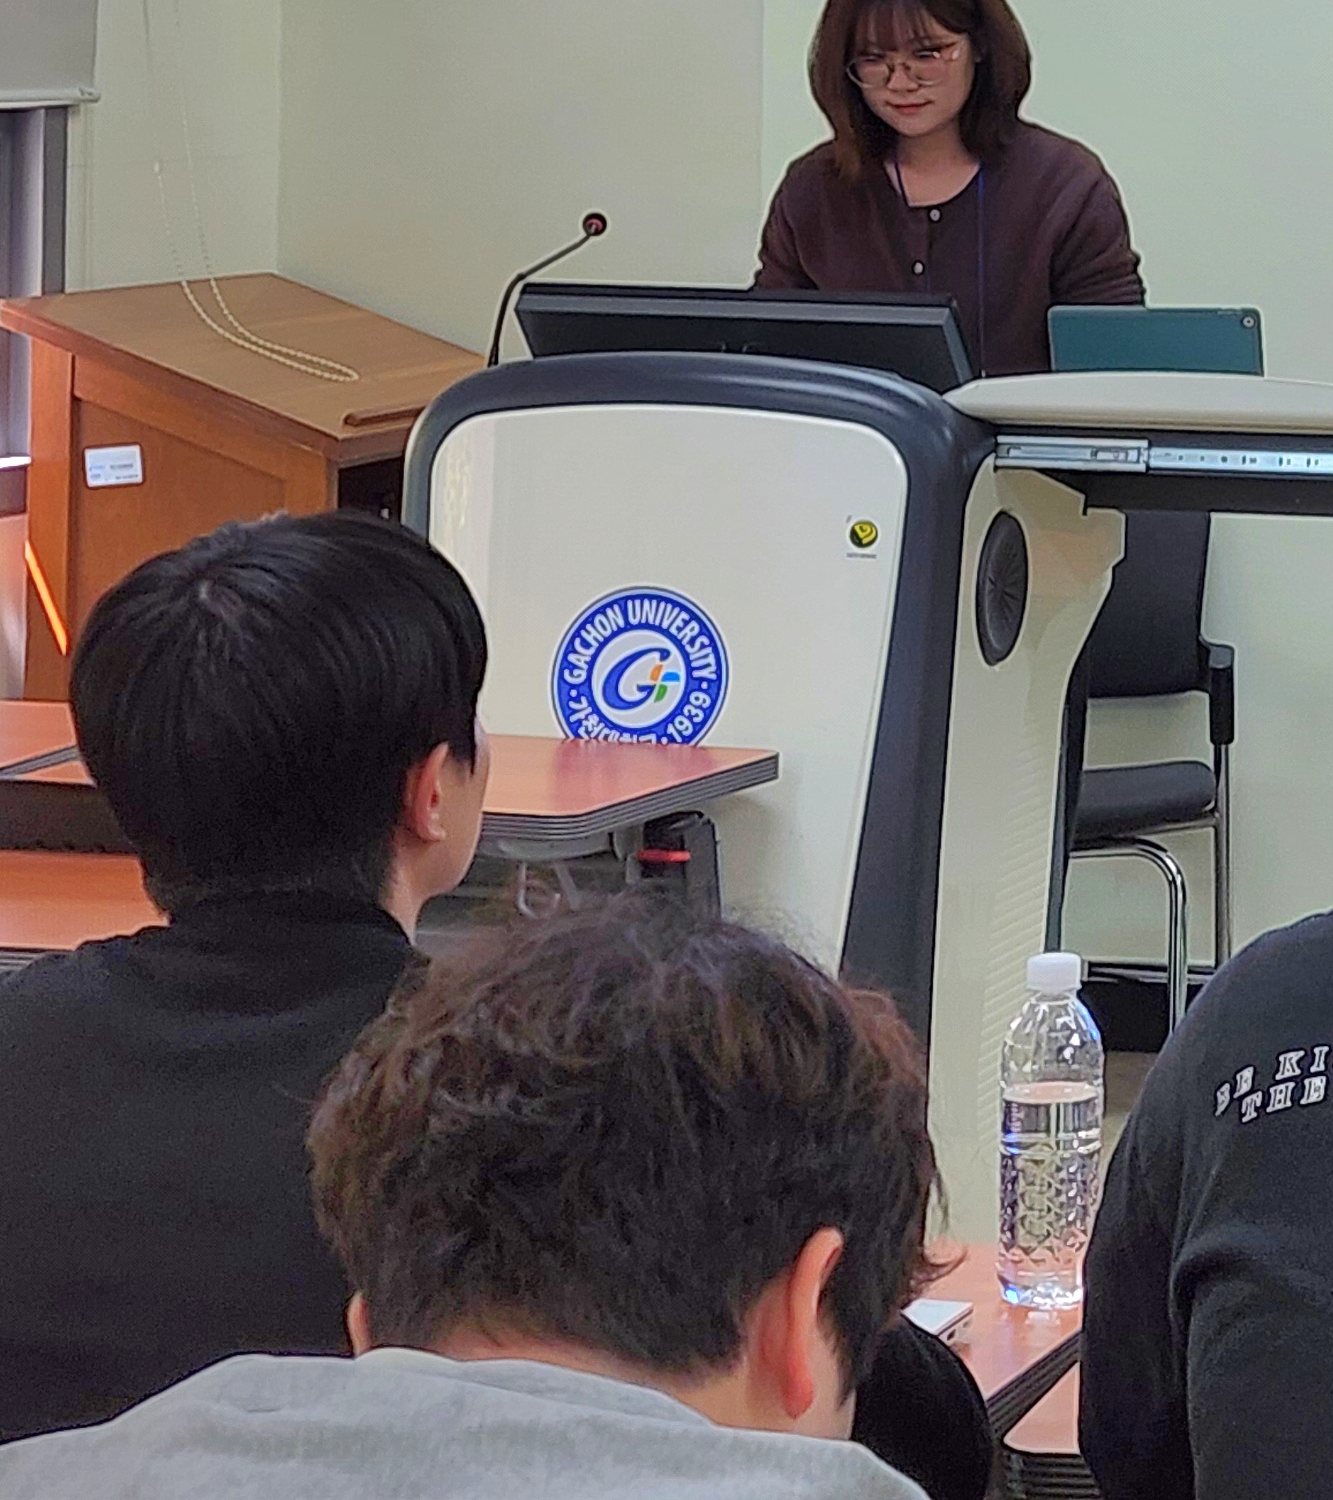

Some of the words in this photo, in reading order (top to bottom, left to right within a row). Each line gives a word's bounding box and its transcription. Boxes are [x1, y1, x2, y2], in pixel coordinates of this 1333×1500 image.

[563, 603, 625, 685] GACHON
[627, 599, 717, 681] UNIVERSITY
[666, 690, 711, 743] 1939
